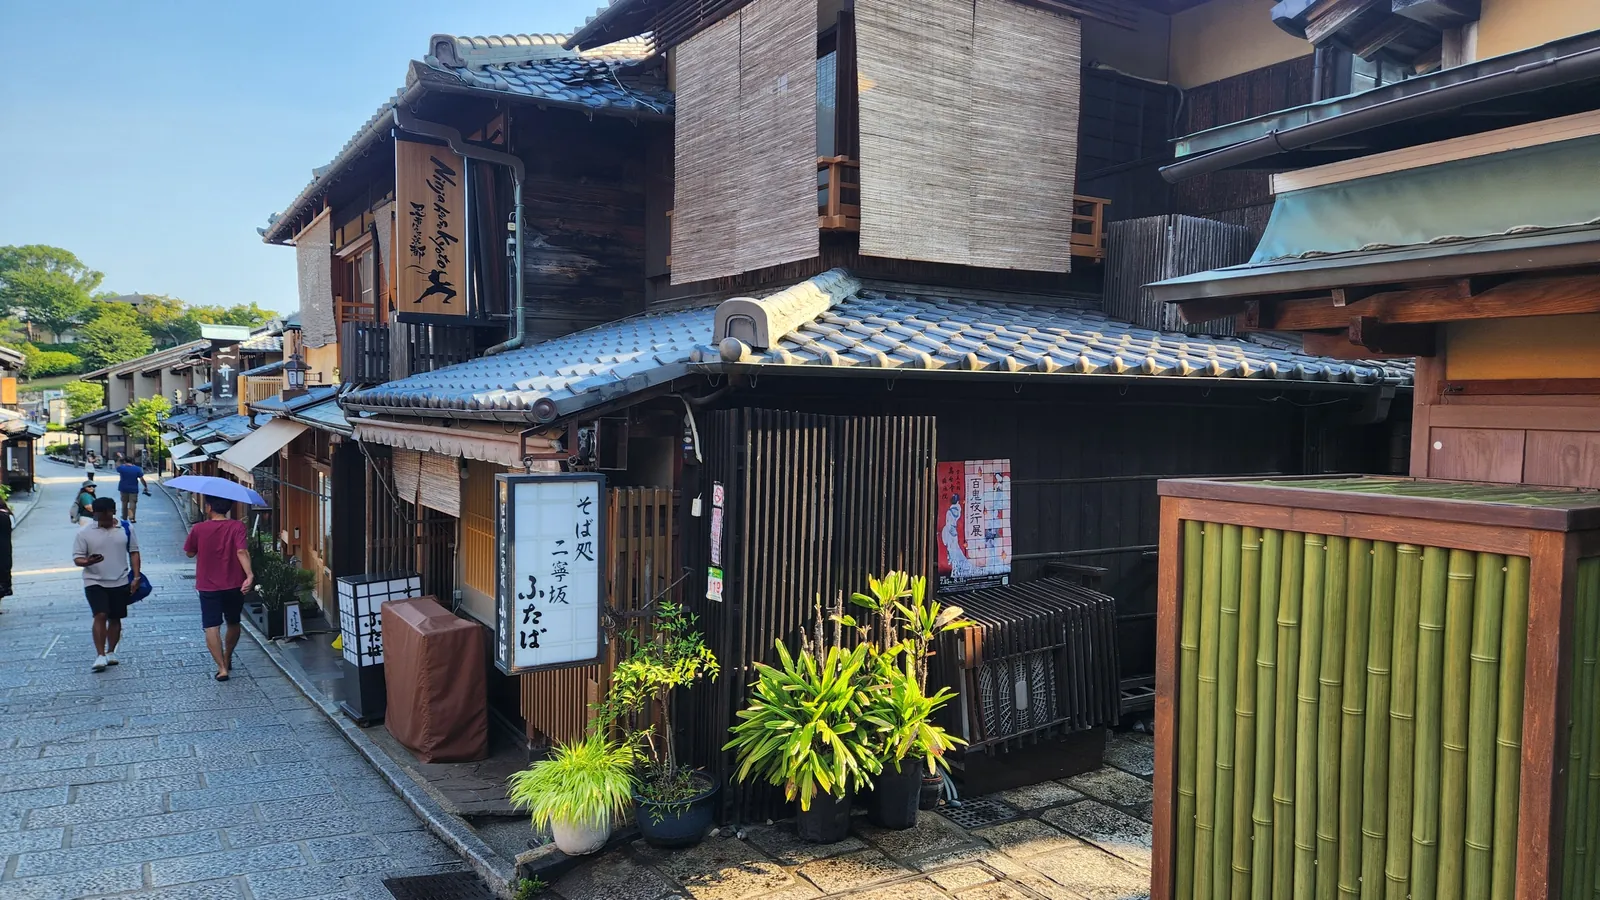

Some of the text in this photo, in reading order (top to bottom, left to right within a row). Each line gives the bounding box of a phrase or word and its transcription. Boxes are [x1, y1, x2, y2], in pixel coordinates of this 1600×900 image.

[426, 155, 457, 204] Ninja
[574, 496, 595, 562] そば処
[970, 477, 982, 537] 百鬼夜行展
[549, 540, 570, 605] 二寧坂
[518, 575, 548, 649] ふたば
